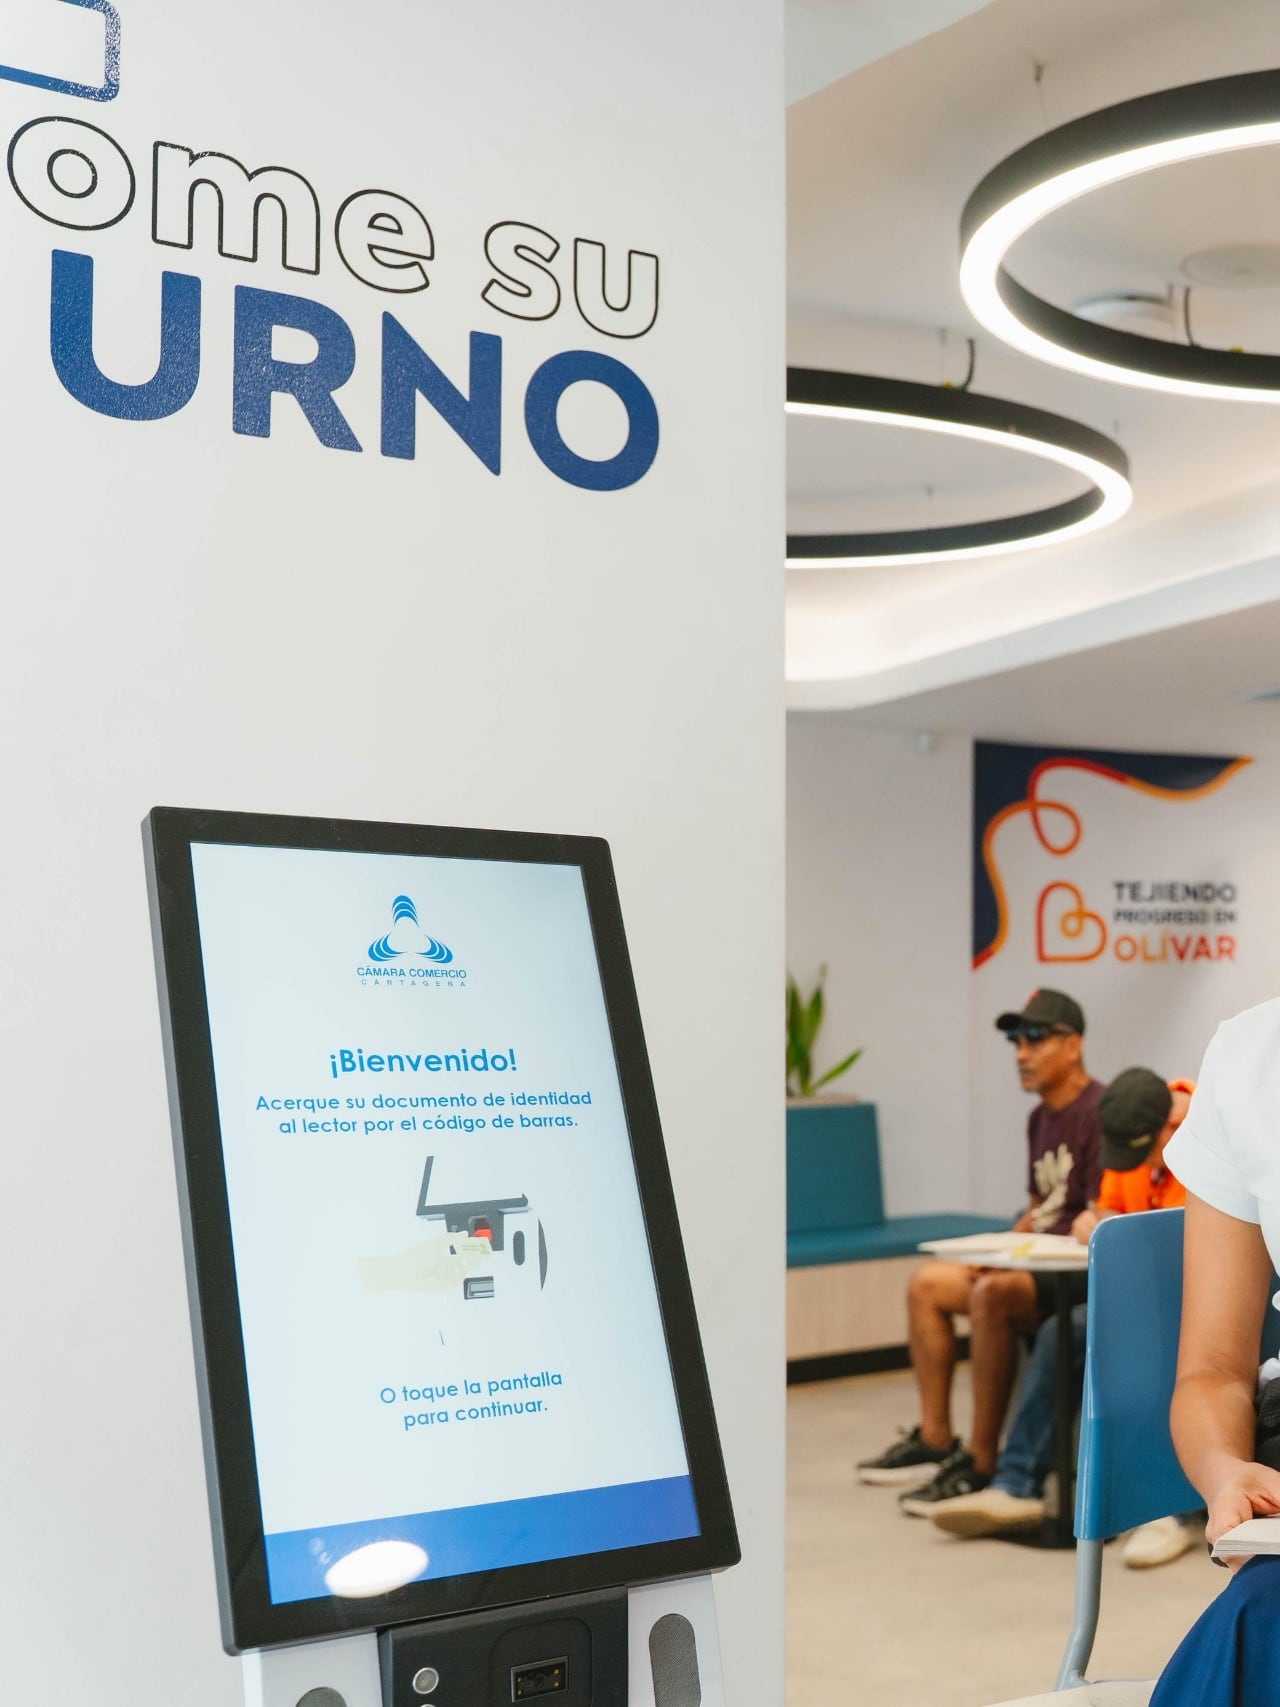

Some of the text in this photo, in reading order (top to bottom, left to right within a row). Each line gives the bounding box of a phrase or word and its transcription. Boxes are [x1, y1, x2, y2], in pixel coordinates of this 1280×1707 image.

[6, 115, 659, 339] ome su
[50, 249, 660, 492] URNO
[1113, 880, 1236, 903] TEJIENDO
[1113, 908, 1237, 924] PROGRESO EN
[357, 965, 467, 979] CÁMARA COMERCIO
[361, 979, 466, 987] CARTAGENA
[330, 1048, 518, 1079] ¡Bienvenido!
[256, 1091, 592, 1114] Acerque su documento de identidad
[279, 1114, 579, 1135] al lector por el código de barras.
[380, 1371, 563, 1404] O toque la pantalla
[403, 1399, 549, 1431] para continuar.
